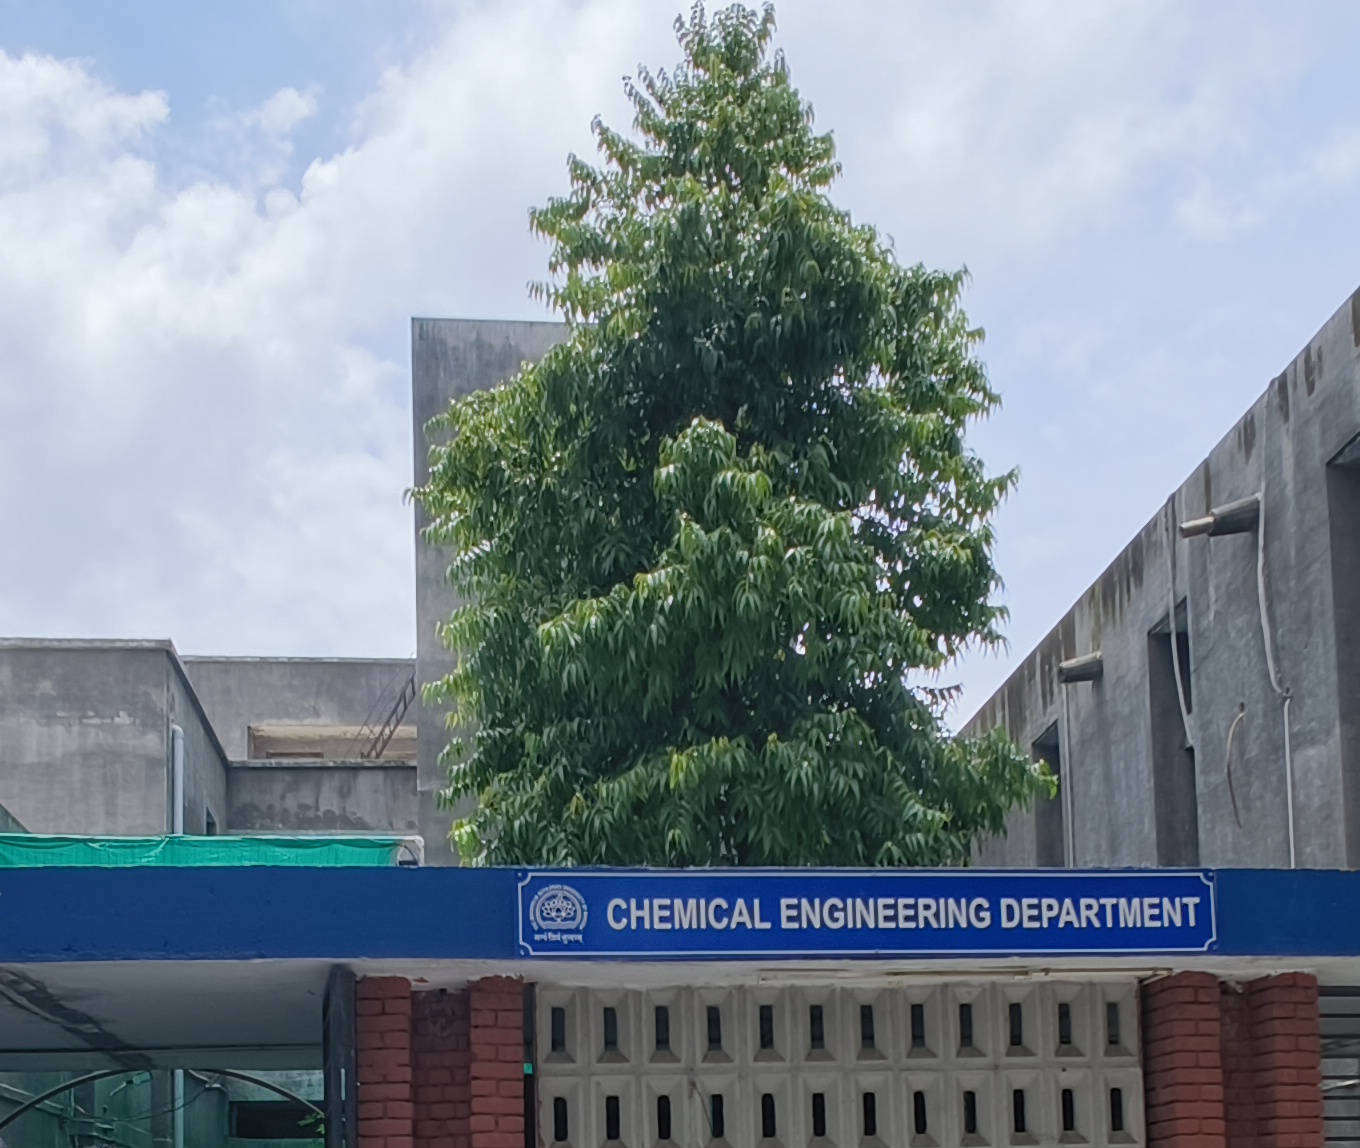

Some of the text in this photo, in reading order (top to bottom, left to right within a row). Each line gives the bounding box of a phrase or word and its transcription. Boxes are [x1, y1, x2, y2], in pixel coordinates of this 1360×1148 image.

[606, 897, 772, 930] CHEMICAL
[780, 897, 991, 929] ENGINEERING
[1000, 896, 1201, 928] DEPARTMENT
